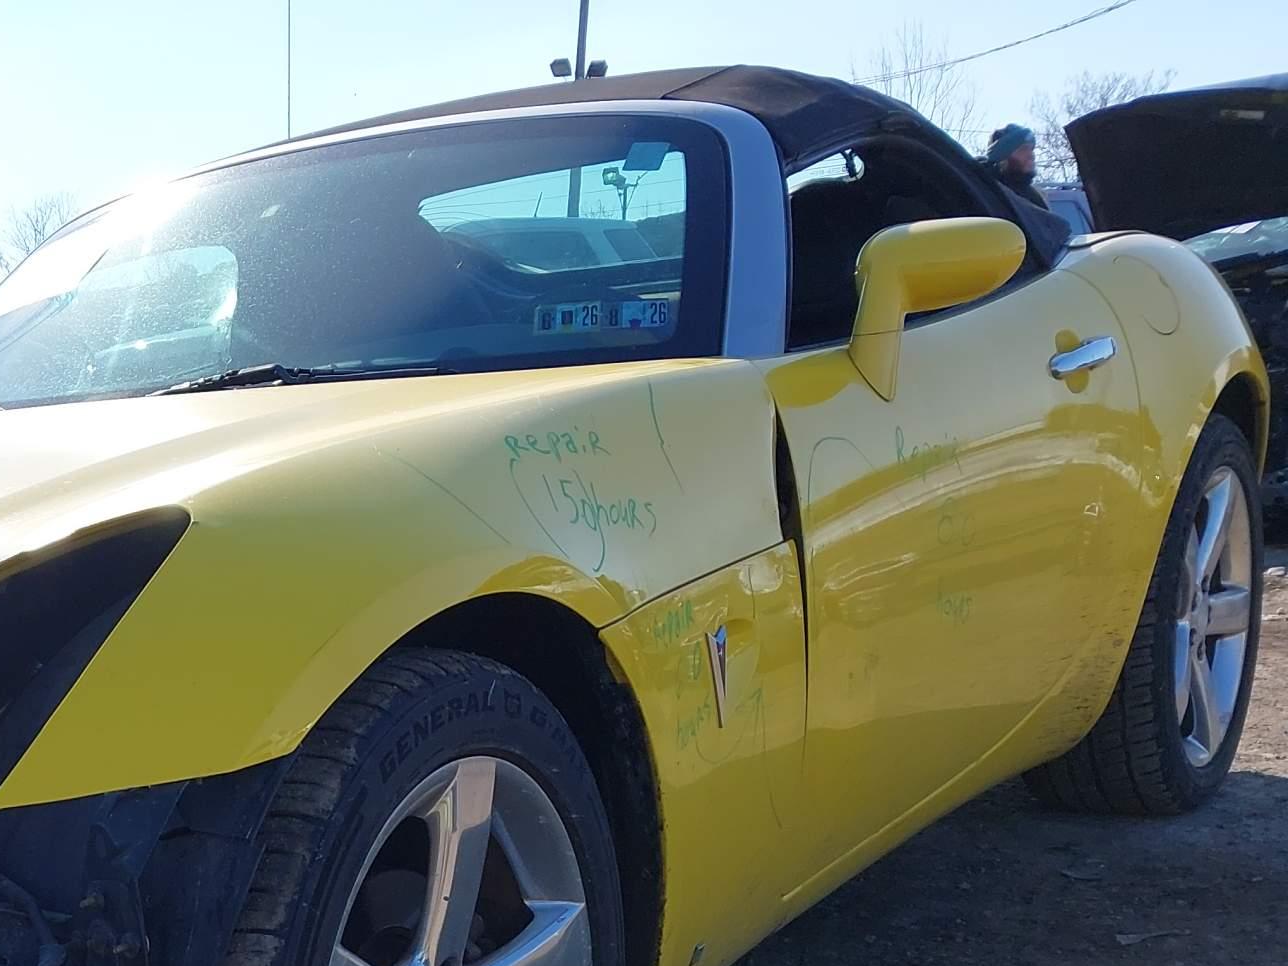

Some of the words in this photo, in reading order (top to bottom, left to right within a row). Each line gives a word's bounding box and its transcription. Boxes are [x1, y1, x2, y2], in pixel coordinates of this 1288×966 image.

[581, 305, 598, 326] 26
[649, 302, 667, 324] 26
[378, 689, 497, 783] GENERAL
